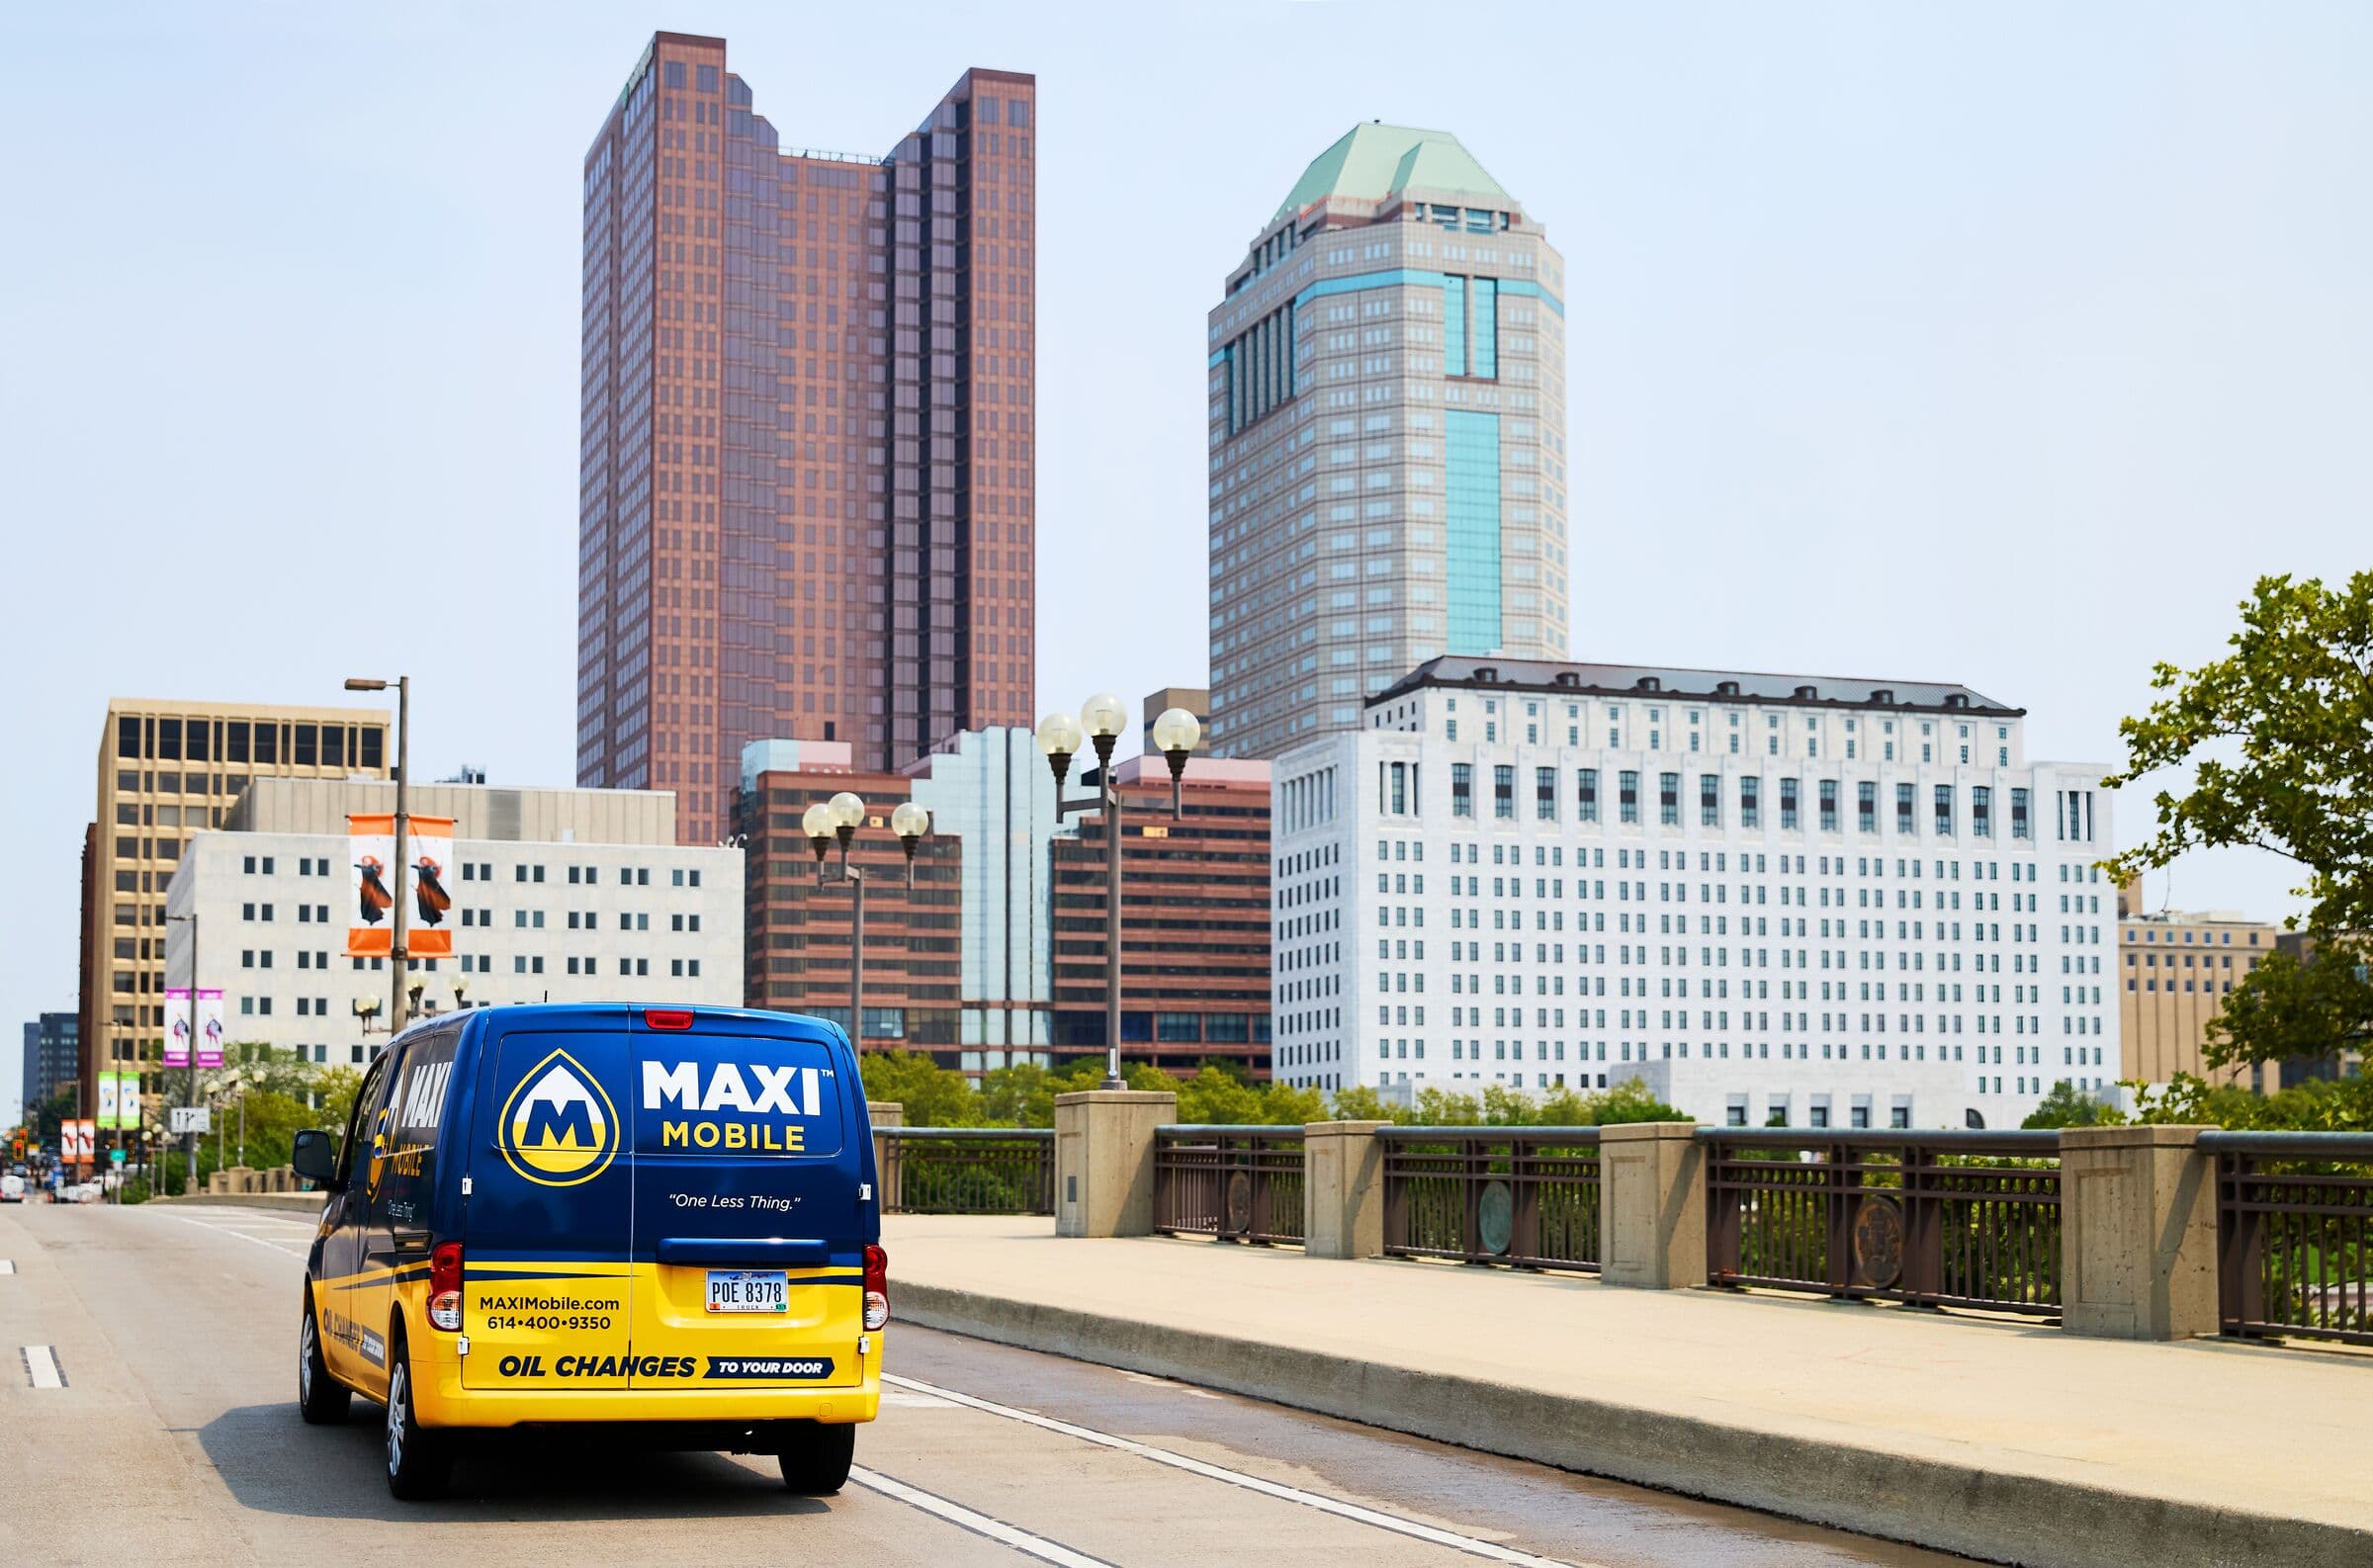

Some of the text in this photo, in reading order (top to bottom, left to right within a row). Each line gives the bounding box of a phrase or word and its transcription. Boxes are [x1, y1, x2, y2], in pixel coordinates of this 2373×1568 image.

[401, 1062, 453, 1128] MAXI
[642, 1061, 821, 1116] MAXI
[662, 1120, 805, 1152] MOBILE
[712, 1194, 745, 1208] Less
[480, 1296, 620, 1310] MAXIMobile.com
[712, 1282, 782, 1303] POE 8378
[498, 1355, 824, 1378] OIL CHANGES TO YOUR DOOR
